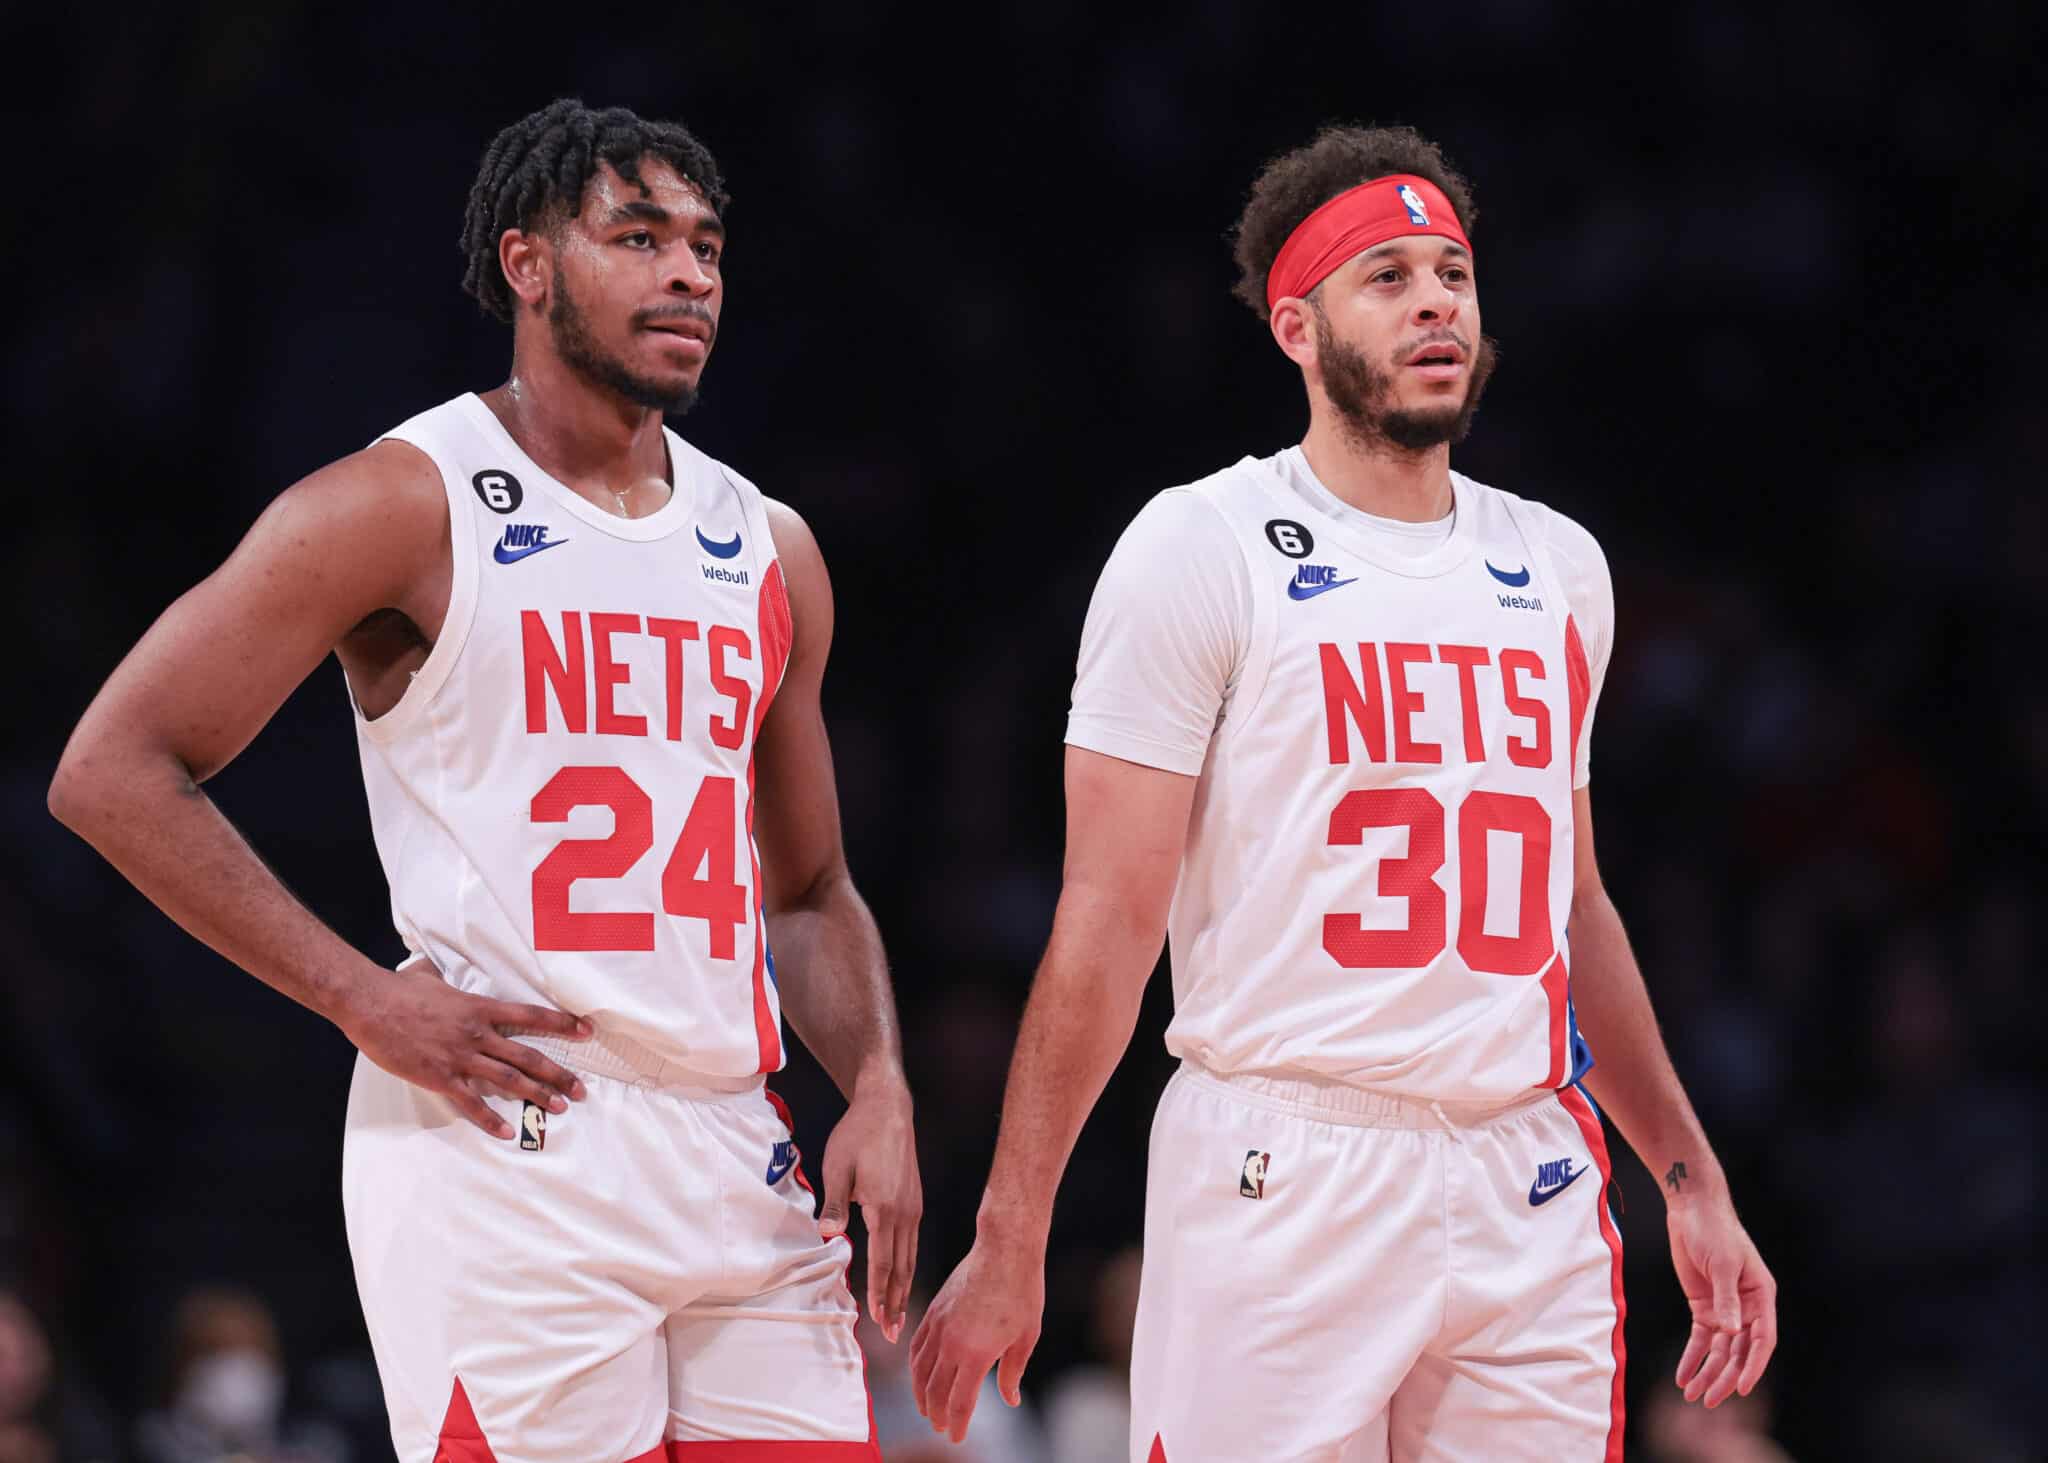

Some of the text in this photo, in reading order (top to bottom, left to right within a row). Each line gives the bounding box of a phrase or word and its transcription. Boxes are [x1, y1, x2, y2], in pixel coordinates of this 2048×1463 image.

[482, 476, 513, 508] 6
[503, 524, 549, 546] NIKE
[1278, 526, 1304, 554] 6
[702, 564, 749, 585] Webull
[1296, 564, 1338, 585] NIKE
[1497, 594, 1543, 611] Webull
[520, 610, 752, 750] NETS
[1319, 642, 1552, 769] NETS
[530, 766, 747, 960] 24
[1322, 788, 1555, 976] 30
[1537, 1158, 1572, 1188] NIKE
